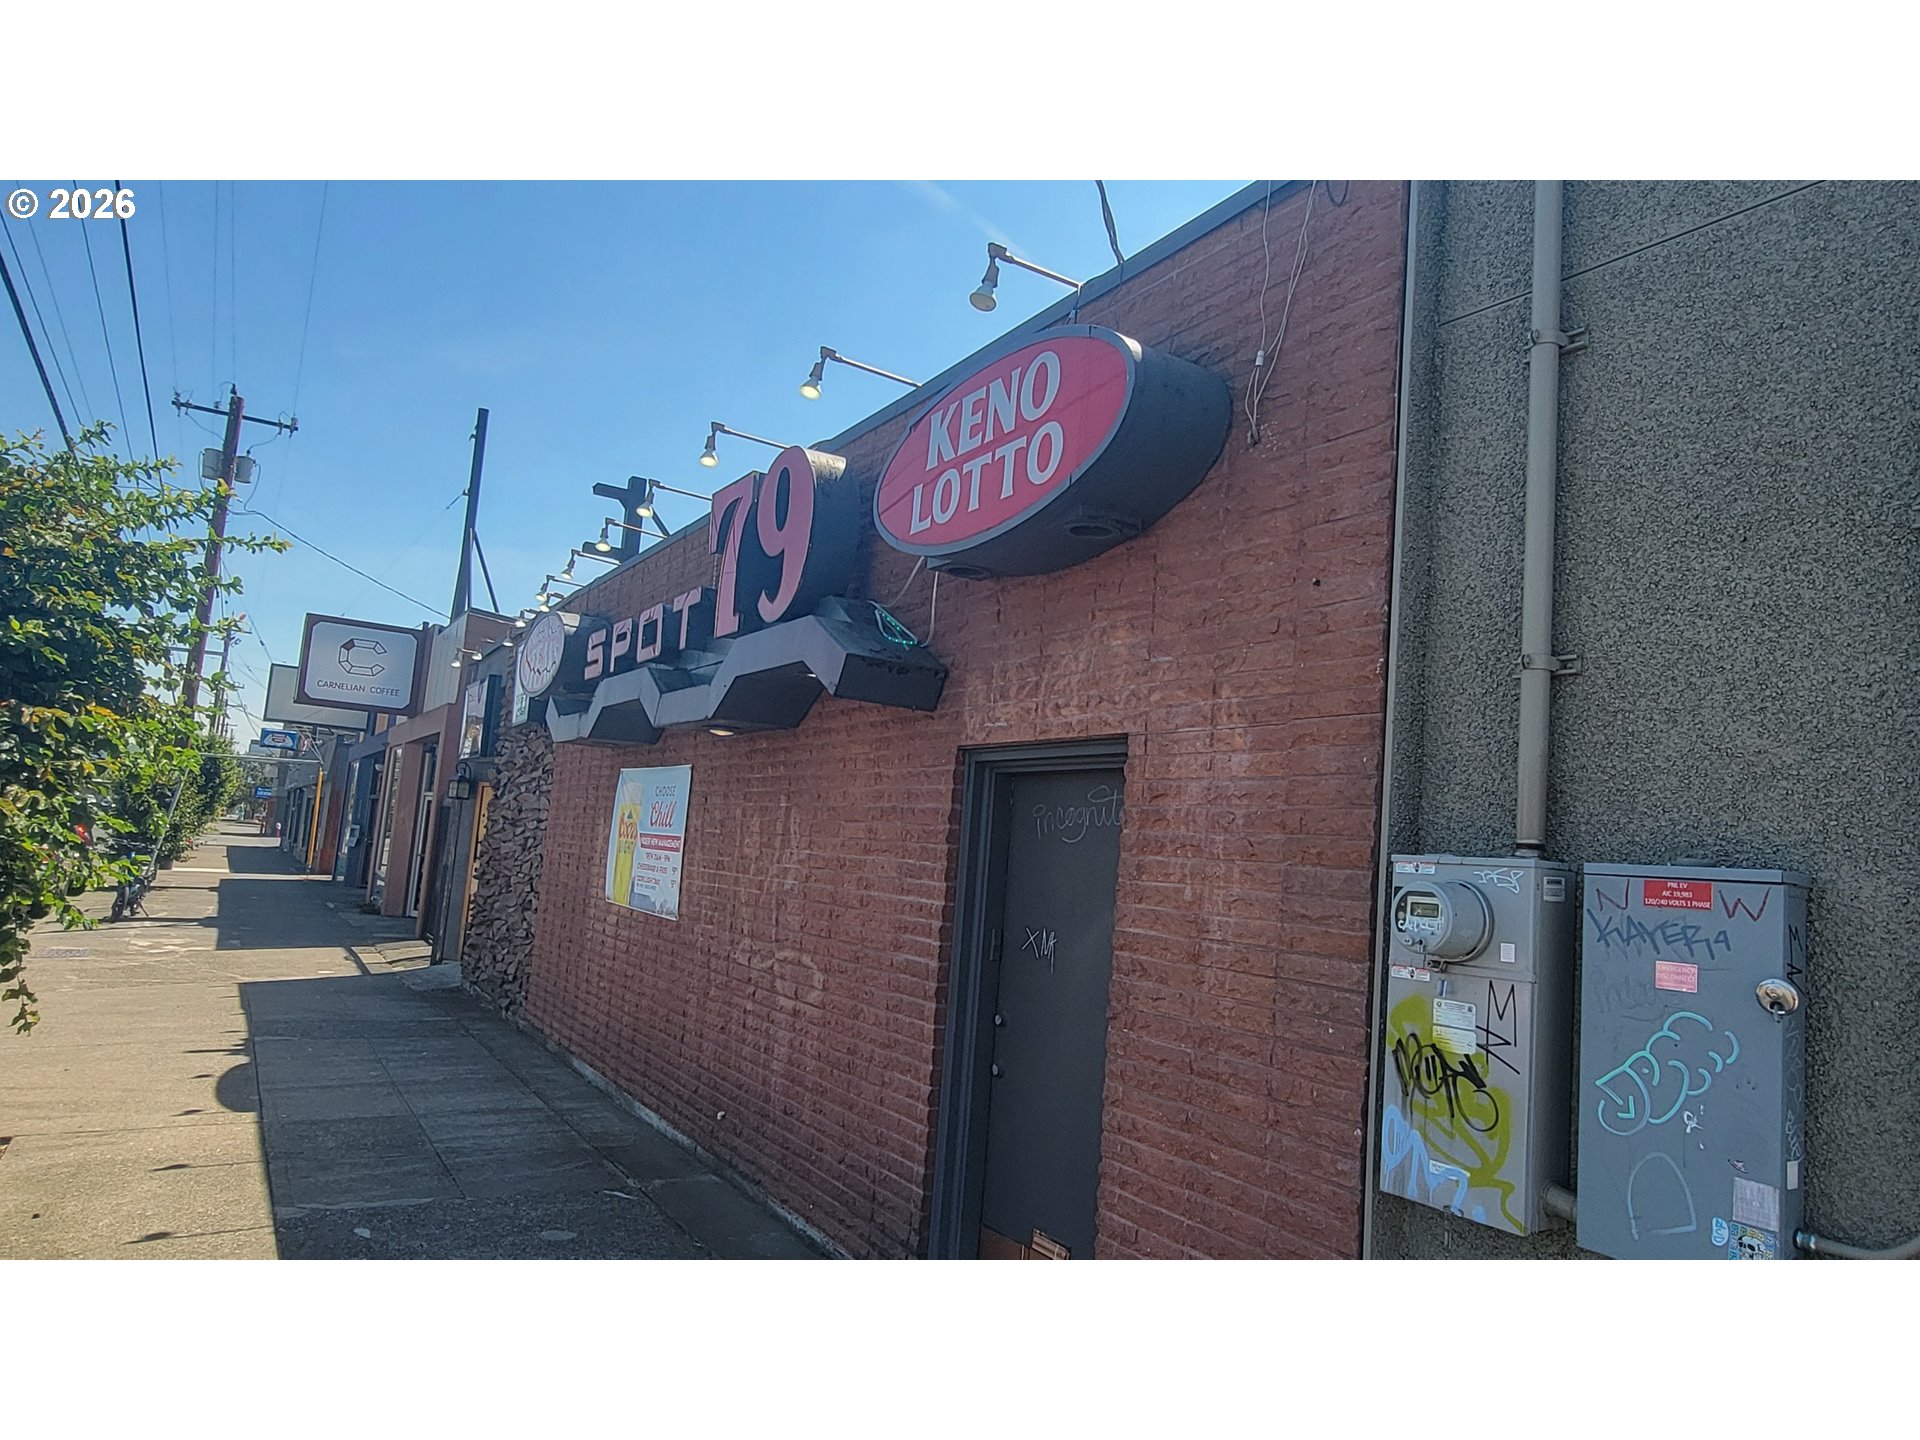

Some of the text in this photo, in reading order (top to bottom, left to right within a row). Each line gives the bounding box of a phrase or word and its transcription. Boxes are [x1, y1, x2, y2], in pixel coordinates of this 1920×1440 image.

[925, 350, 1061, 472] KENO
[909, 420, 1064, 536] LOTTO
[584, 586, 701, 681] SPOT
[709, 445, 815, 639] 79
[316, 679, 400, 697] CARNELIAN COFFEE
[649, 800, 677, 828] Chill
[1668, 899, 1687, 907] VOLTS
[1691, 901, 1711, 909] PHASE
